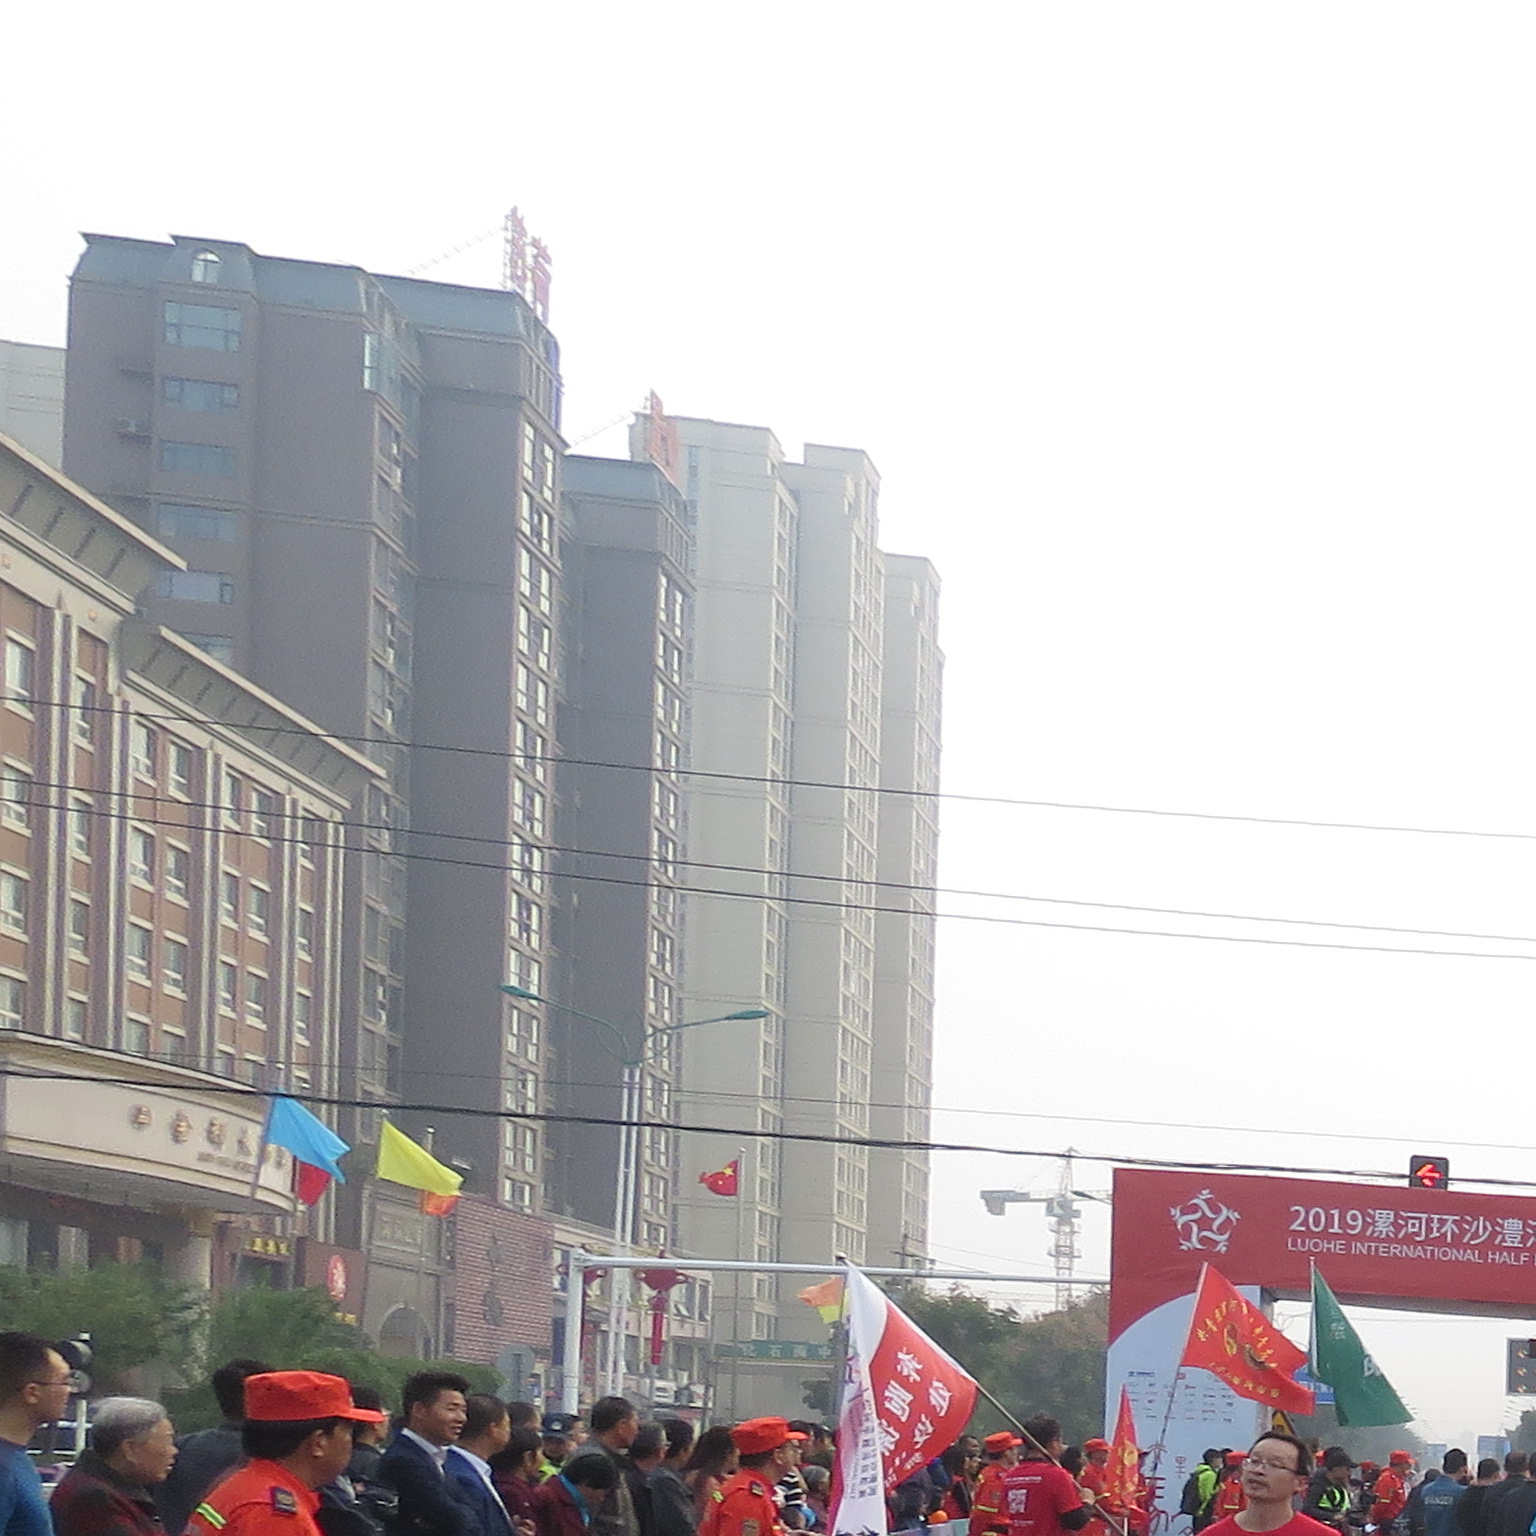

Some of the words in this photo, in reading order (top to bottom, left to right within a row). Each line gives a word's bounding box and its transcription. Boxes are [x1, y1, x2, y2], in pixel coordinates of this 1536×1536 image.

[1287, 1237, 1347, 1255] LUOHE
[1351, 1241, 1484, 1264] INTERNATIONAL
[1487, 1251, 1530, 1266] HALF
